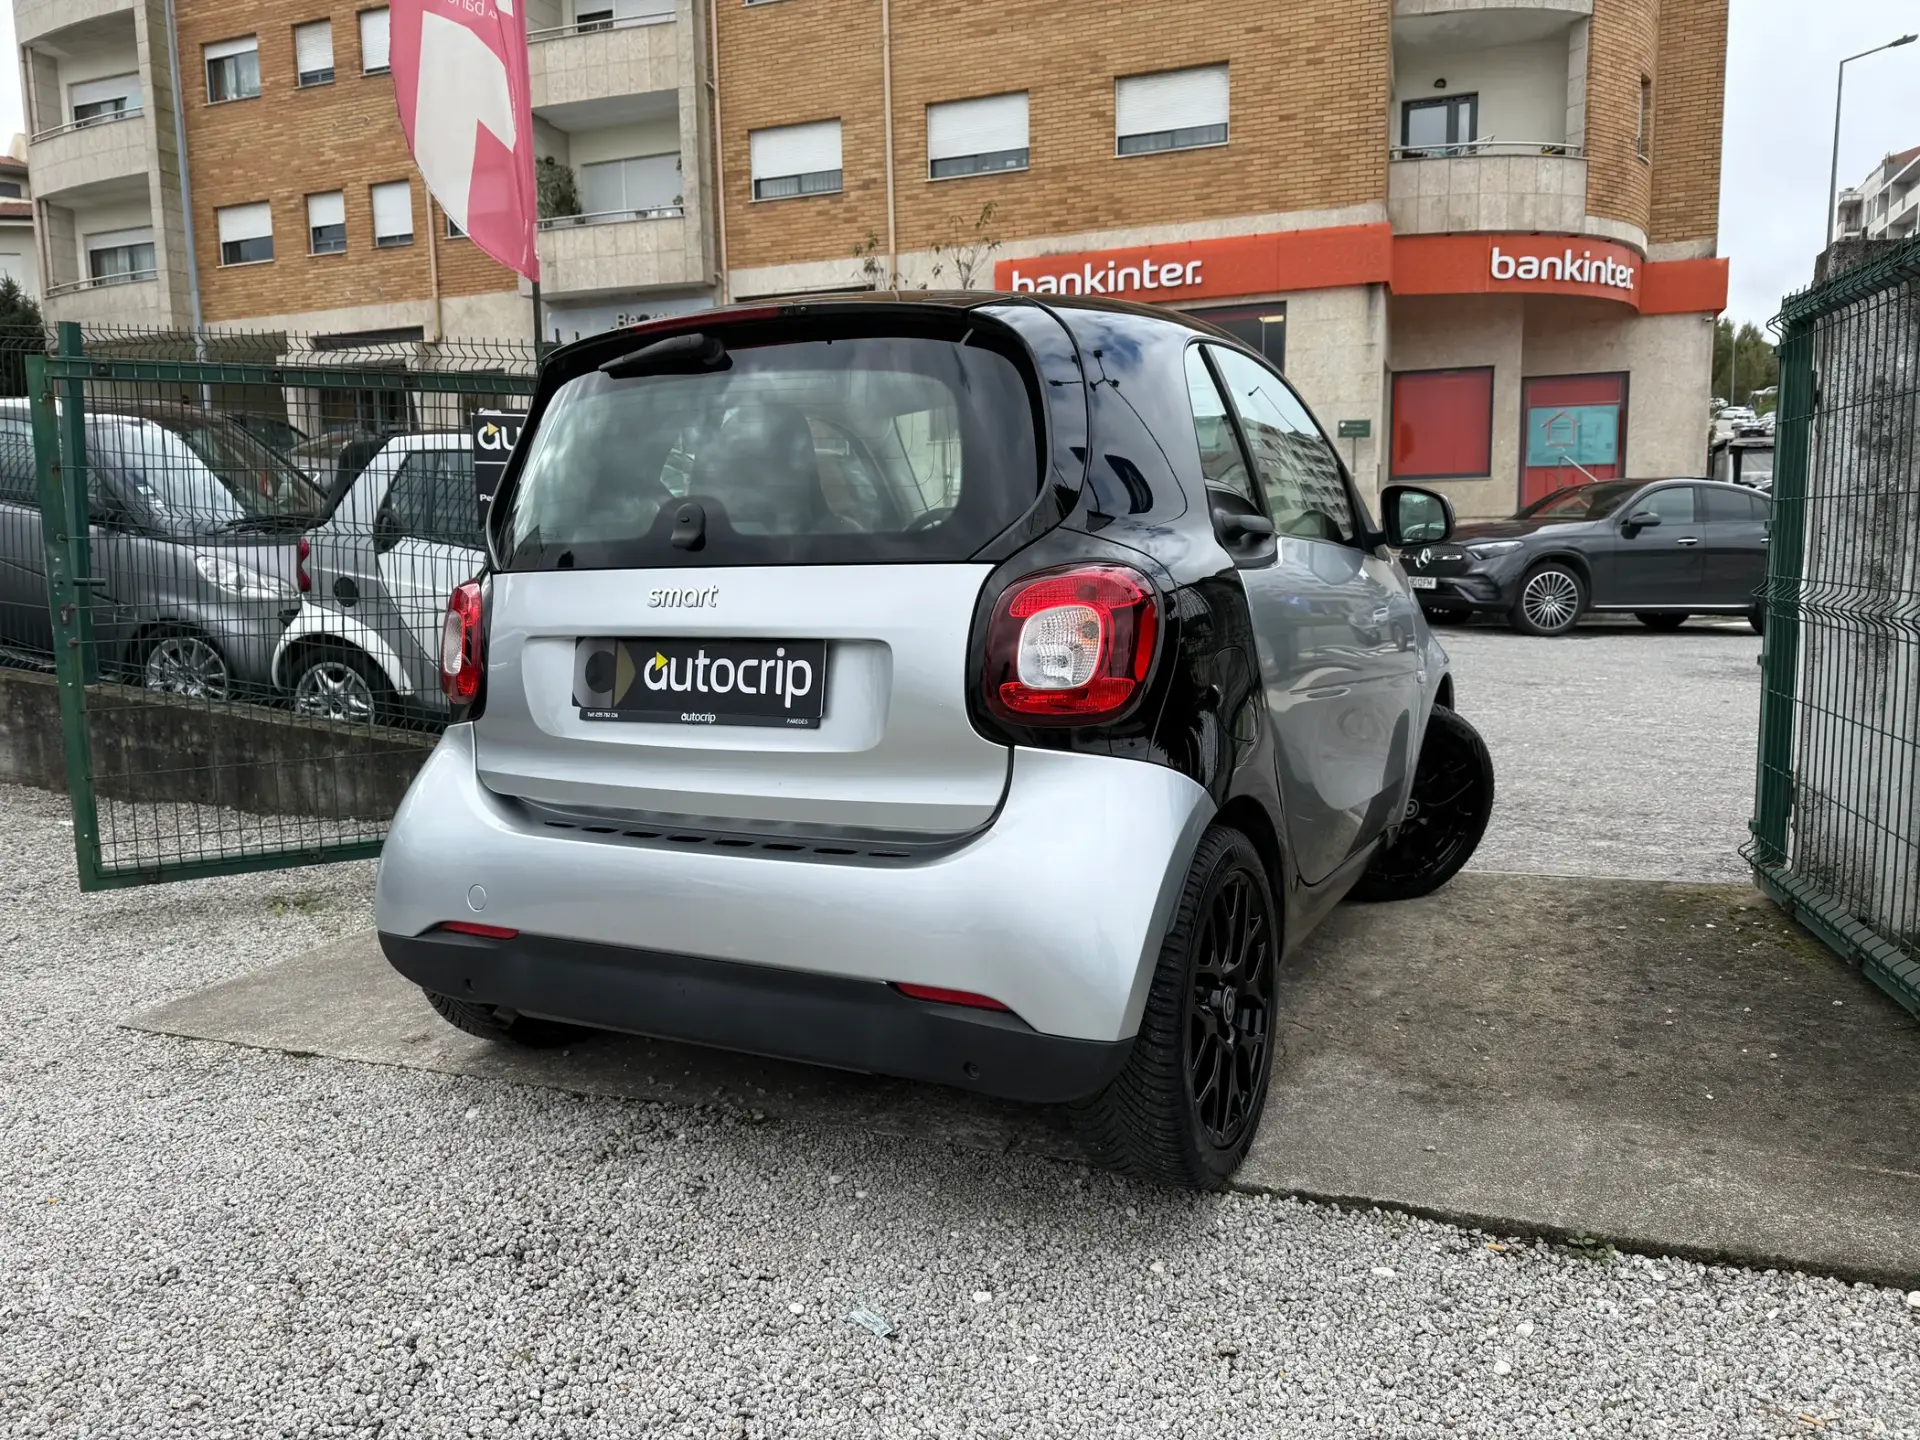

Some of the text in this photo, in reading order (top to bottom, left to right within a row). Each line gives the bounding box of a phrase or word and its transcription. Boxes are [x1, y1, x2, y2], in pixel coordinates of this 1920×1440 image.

[647, 585, 719, 608] smart
[643, 647, 813, 708] autocrip
[680, 711, 717, 724] autocrip
[786, 717, 809, 725] PAREDES
